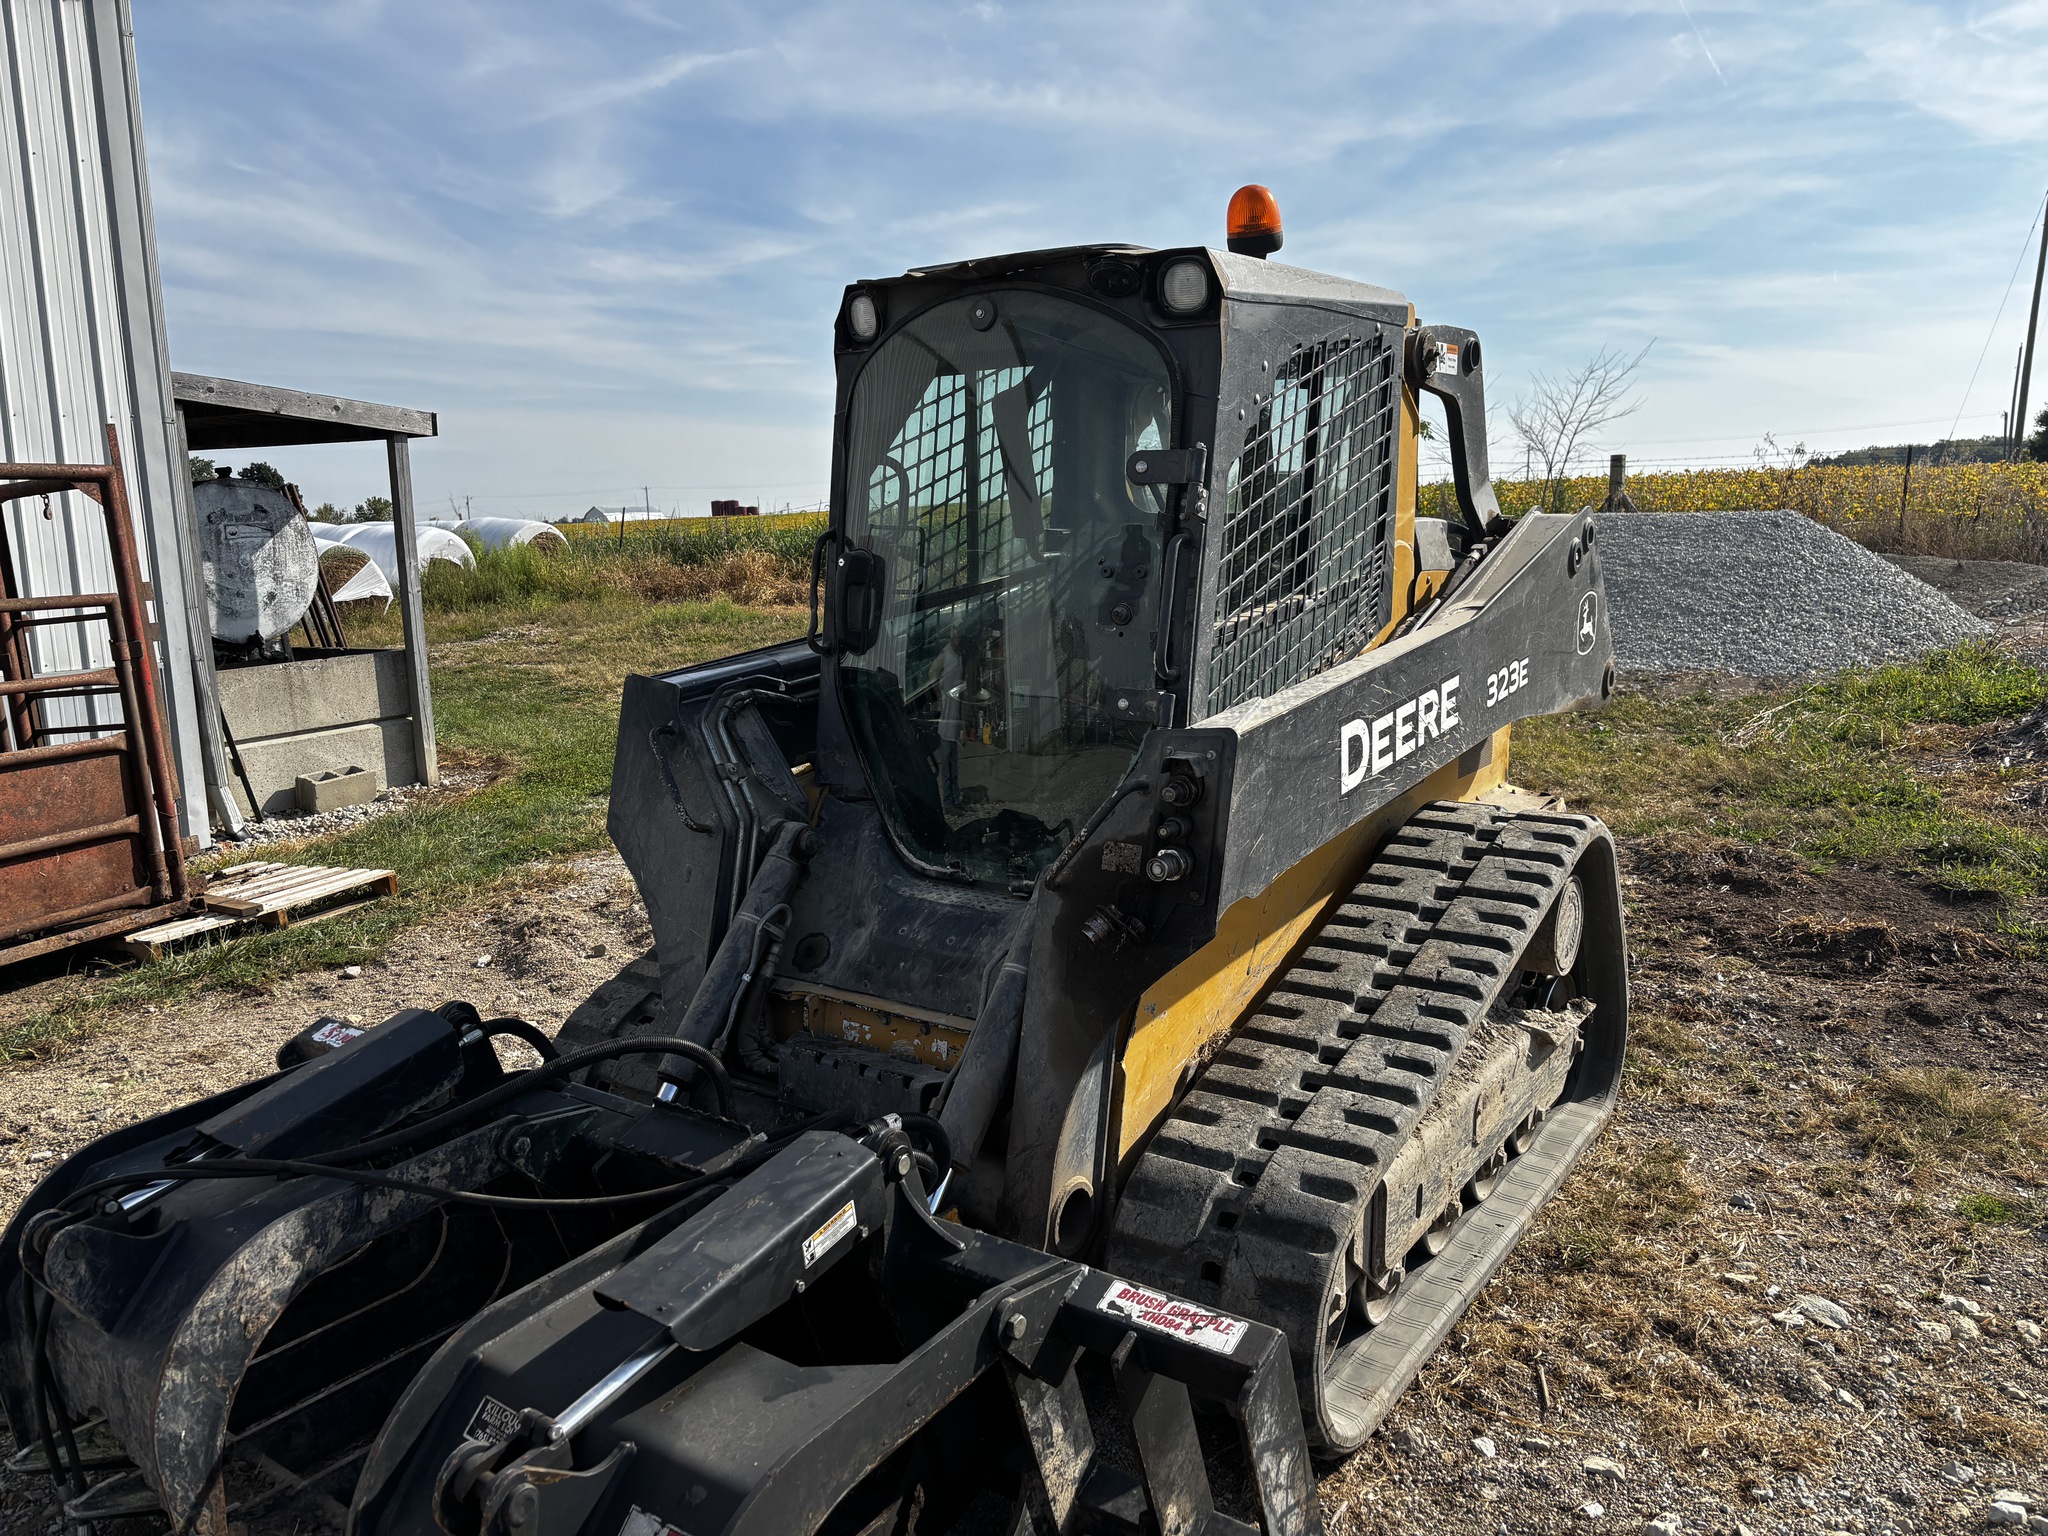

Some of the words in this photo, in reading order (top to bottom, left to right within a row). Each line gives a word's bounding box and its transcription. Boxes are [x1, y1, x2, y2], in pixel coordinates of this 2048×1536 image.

[1486, 657, 1530, 708] 323E
[1340, 674, 1461, 796] DEERE
[1116, 1287, 1169, 1312] BRUSH
[1166, 1304, 1236, 1336] GRAPPLE
[482, 1411, 501, 1428] FARM
